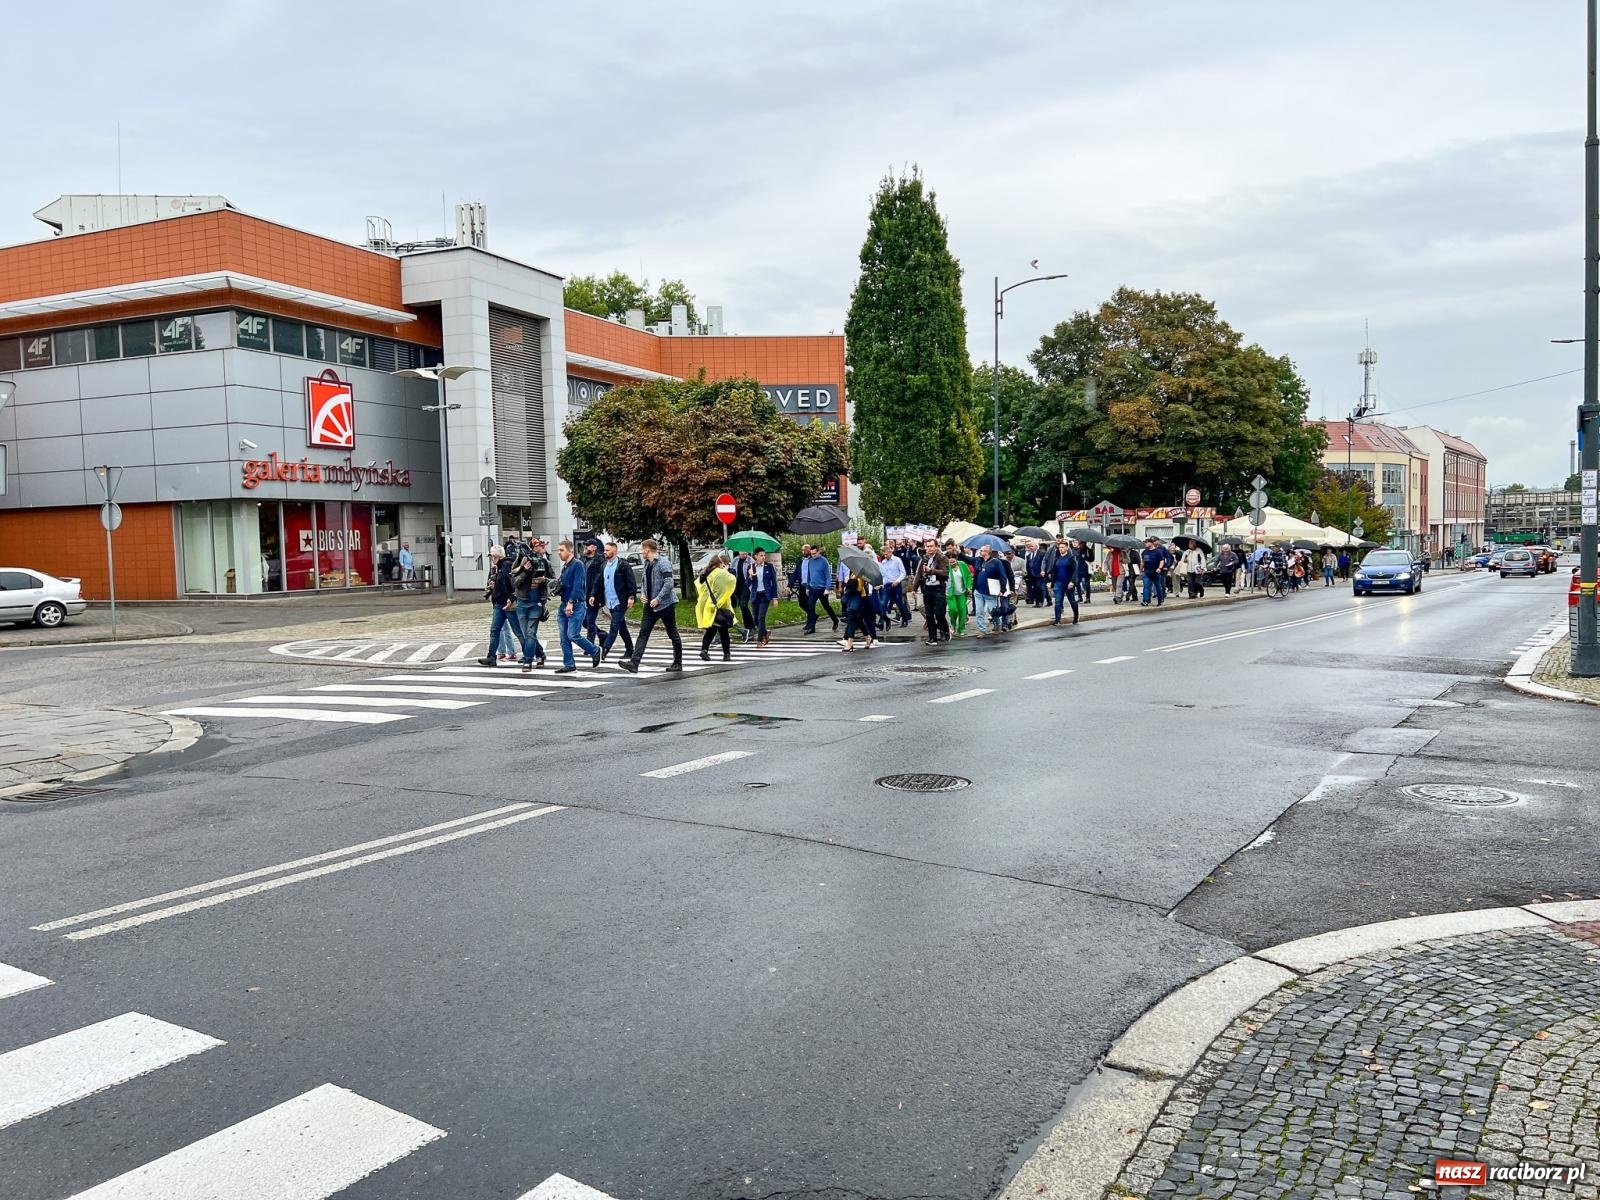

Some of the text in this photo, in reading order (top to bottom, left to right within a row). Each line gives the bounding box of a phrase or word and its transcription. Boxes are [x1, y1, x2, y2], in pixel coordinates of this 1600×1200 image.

[239, 315, 266, 334] 4F
[28, 336, 50, 355] 4F
[340, 336, 364, 354] 4F
[242, 451, 412, 492] galeria młyńska
[1095, 505, 1115, 515] BAR
[319, 529, 361, 551] BIG STAR
